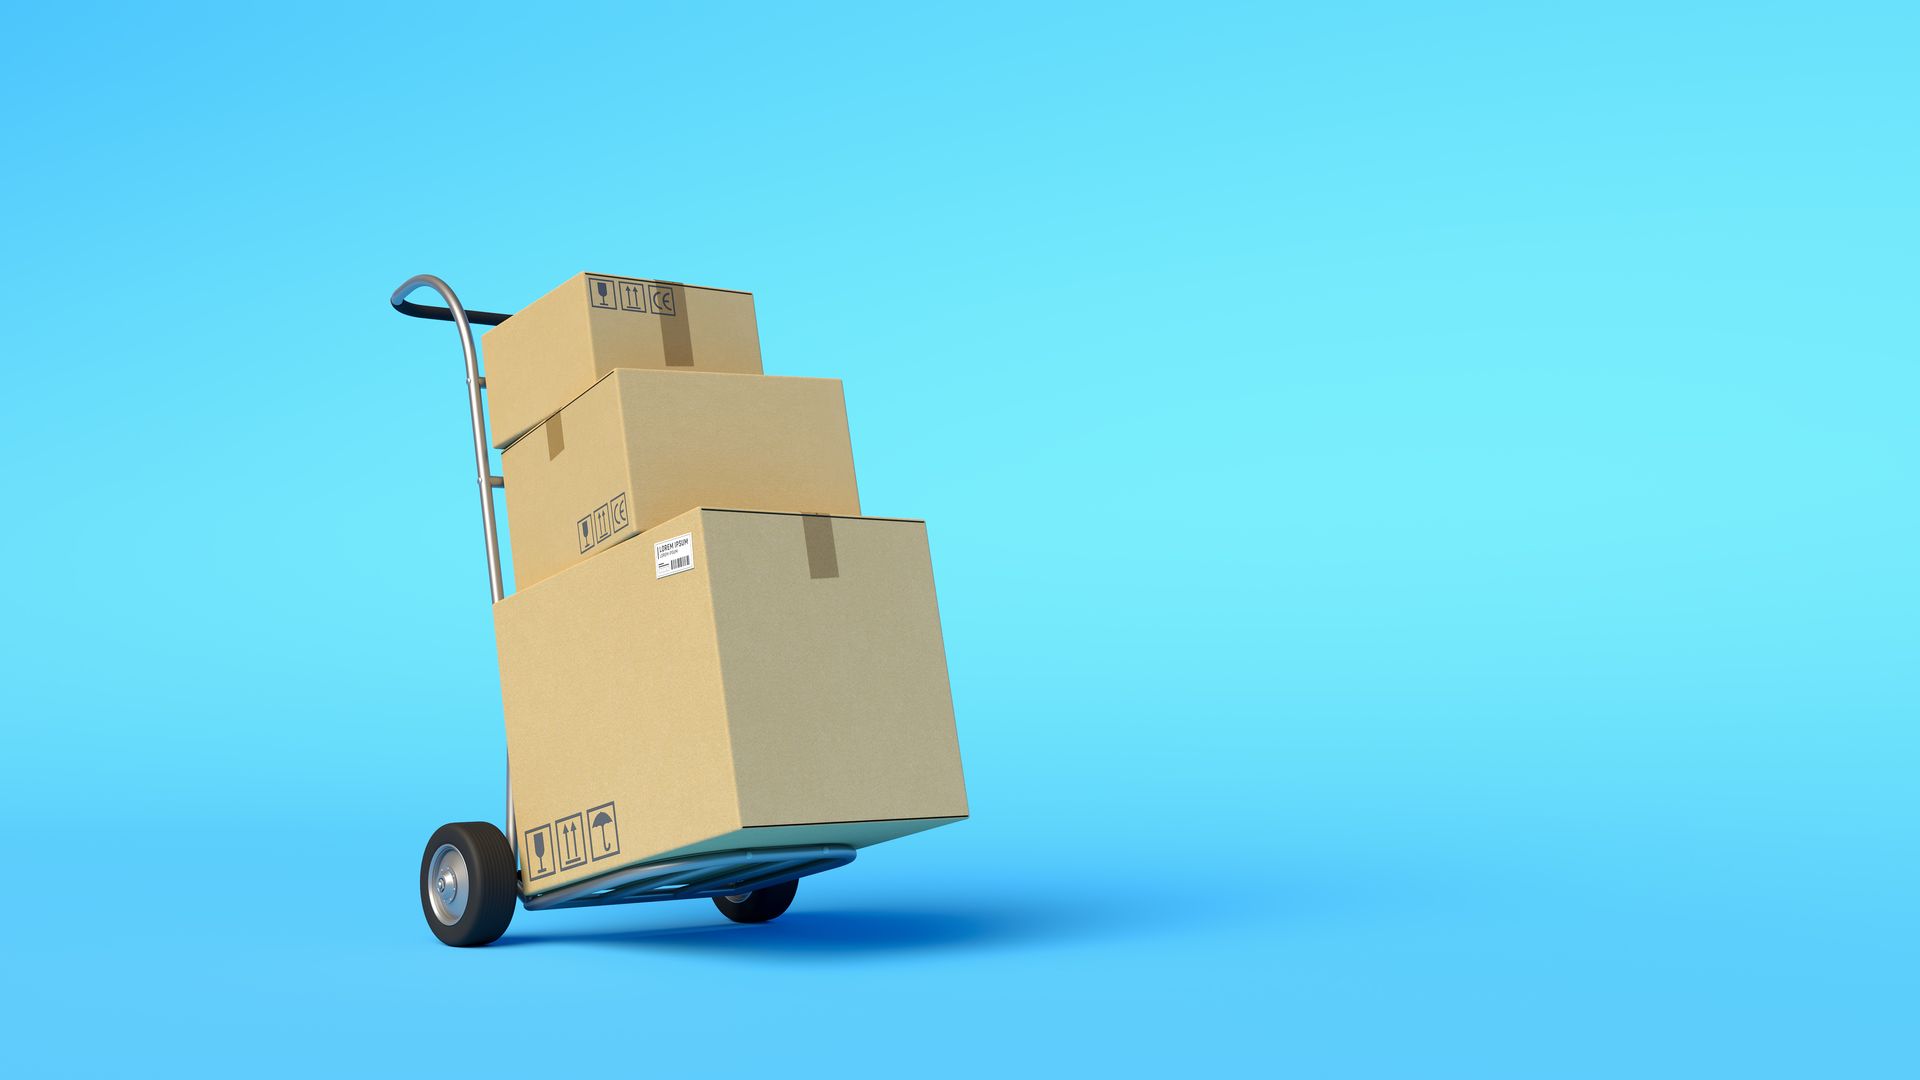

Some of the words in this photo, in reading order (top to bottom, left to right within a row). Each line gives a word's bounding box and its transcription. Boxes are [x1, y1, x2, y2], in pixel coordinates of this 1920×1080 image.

[653, 291, 672, 311] CE
[613, 499, 626, 525] CE
[659, 542, 674, 553] LOREM
[674, 538, 689, 548] IPSUM
